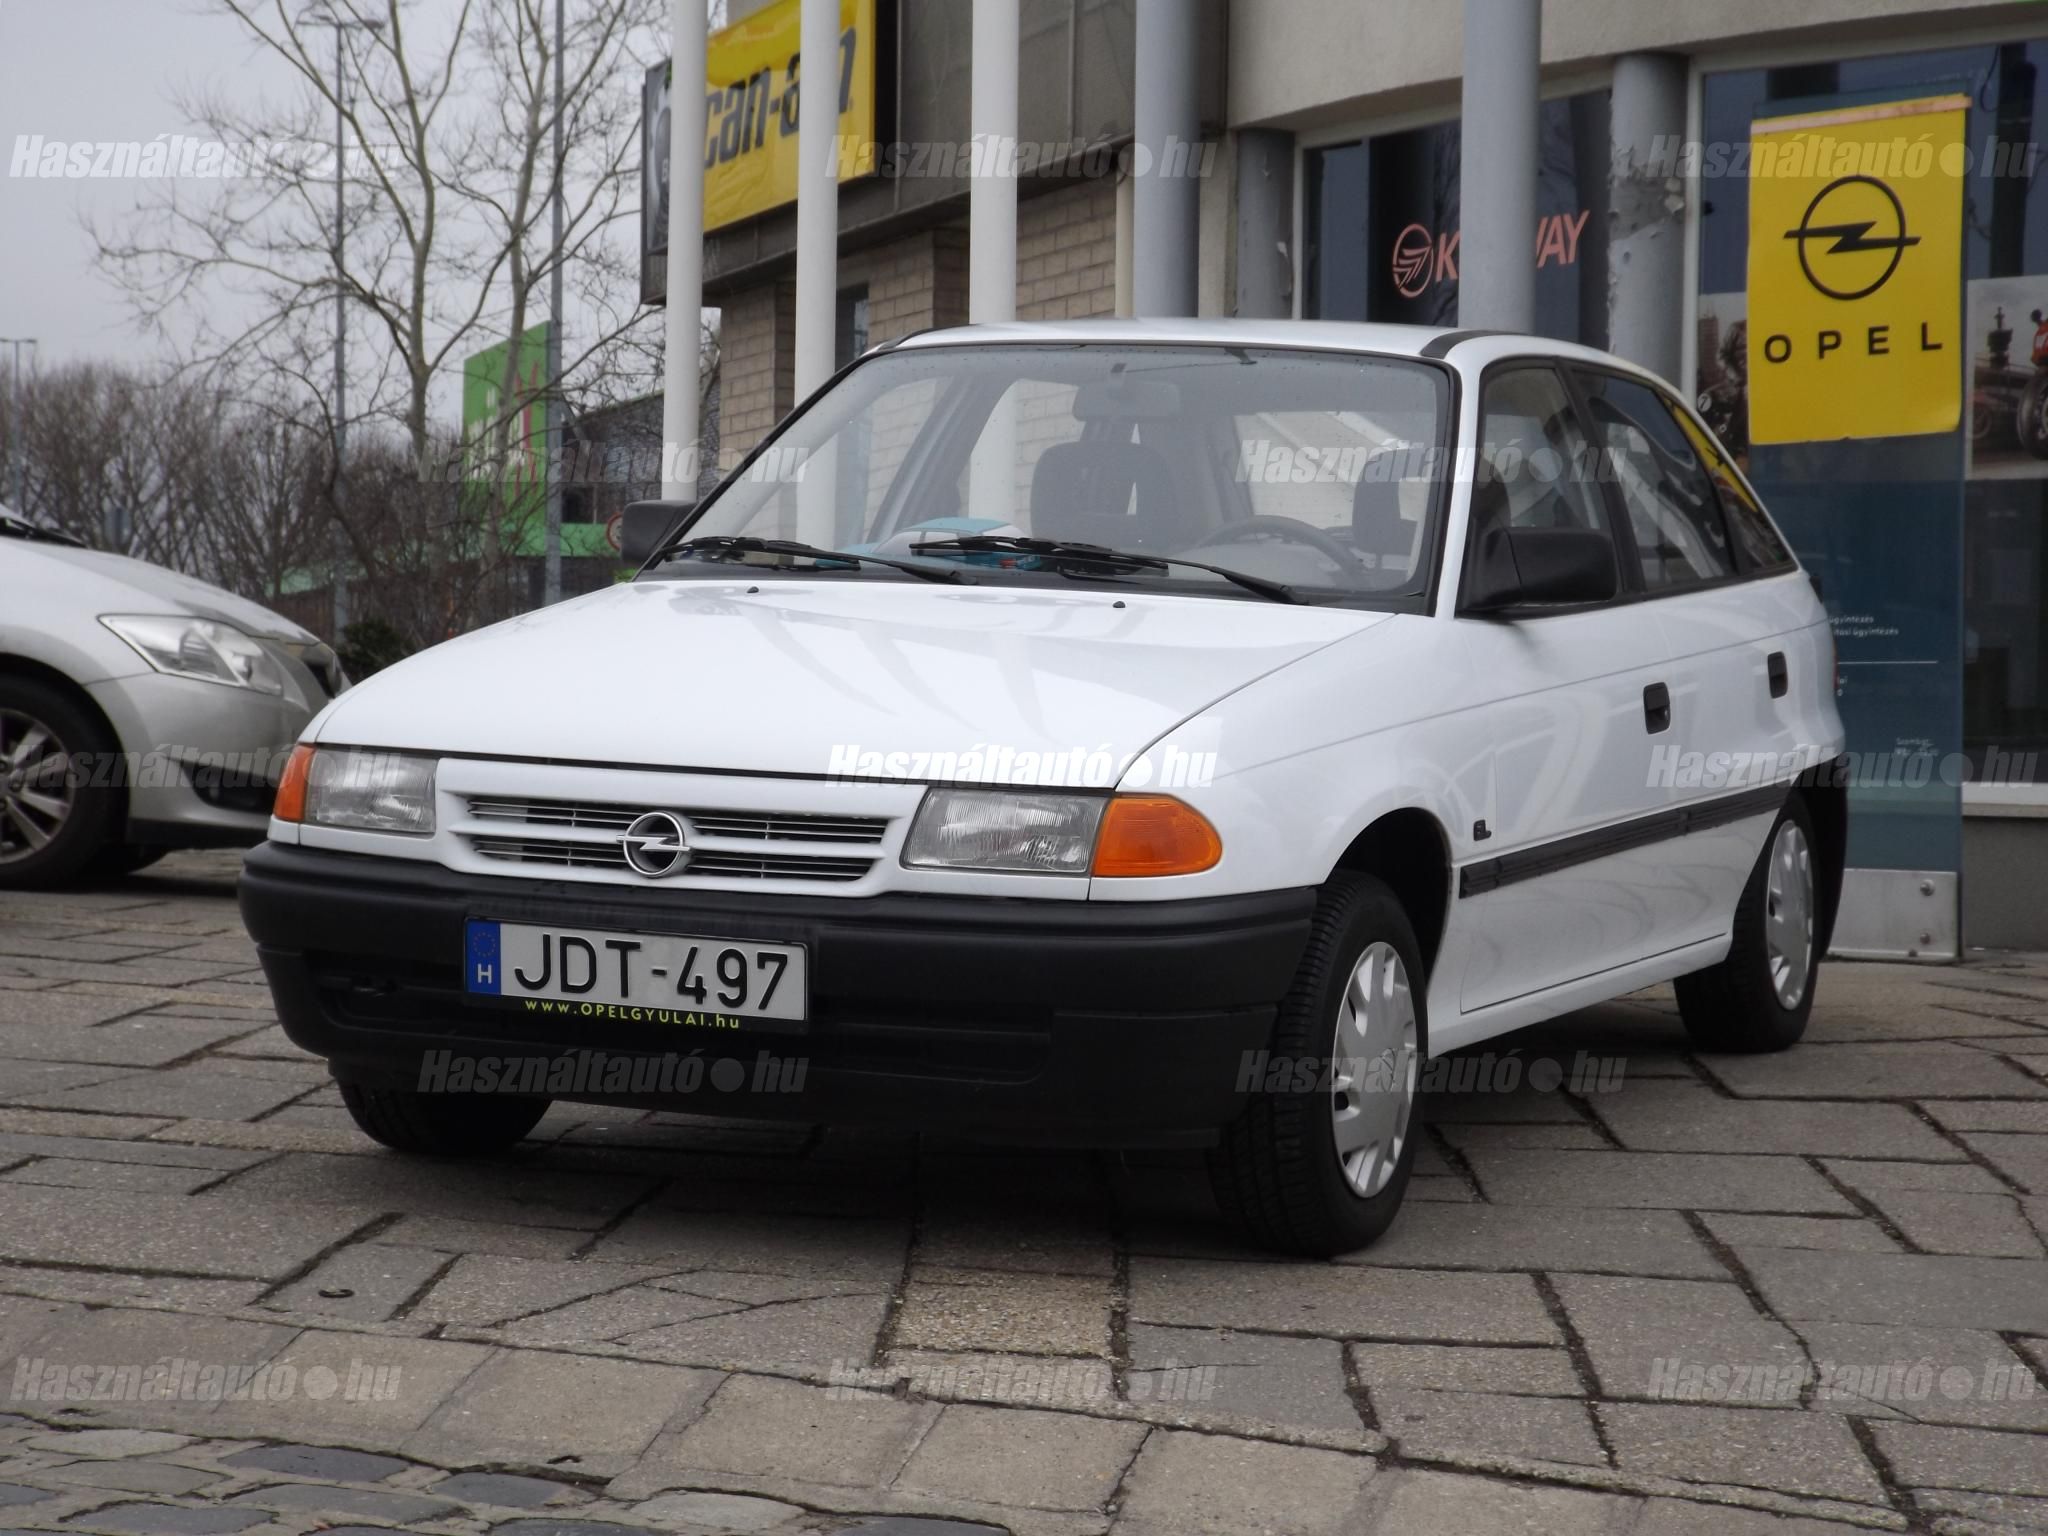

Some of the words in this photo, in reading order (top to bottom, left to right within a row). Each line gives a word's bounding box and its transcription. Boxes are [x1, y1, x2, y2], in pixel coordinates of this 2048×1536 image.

[1764, 322, 1944, 366] OPEL
[477, 962, 492, 985] H
[513, 933, 789, 1011] JDT-497
